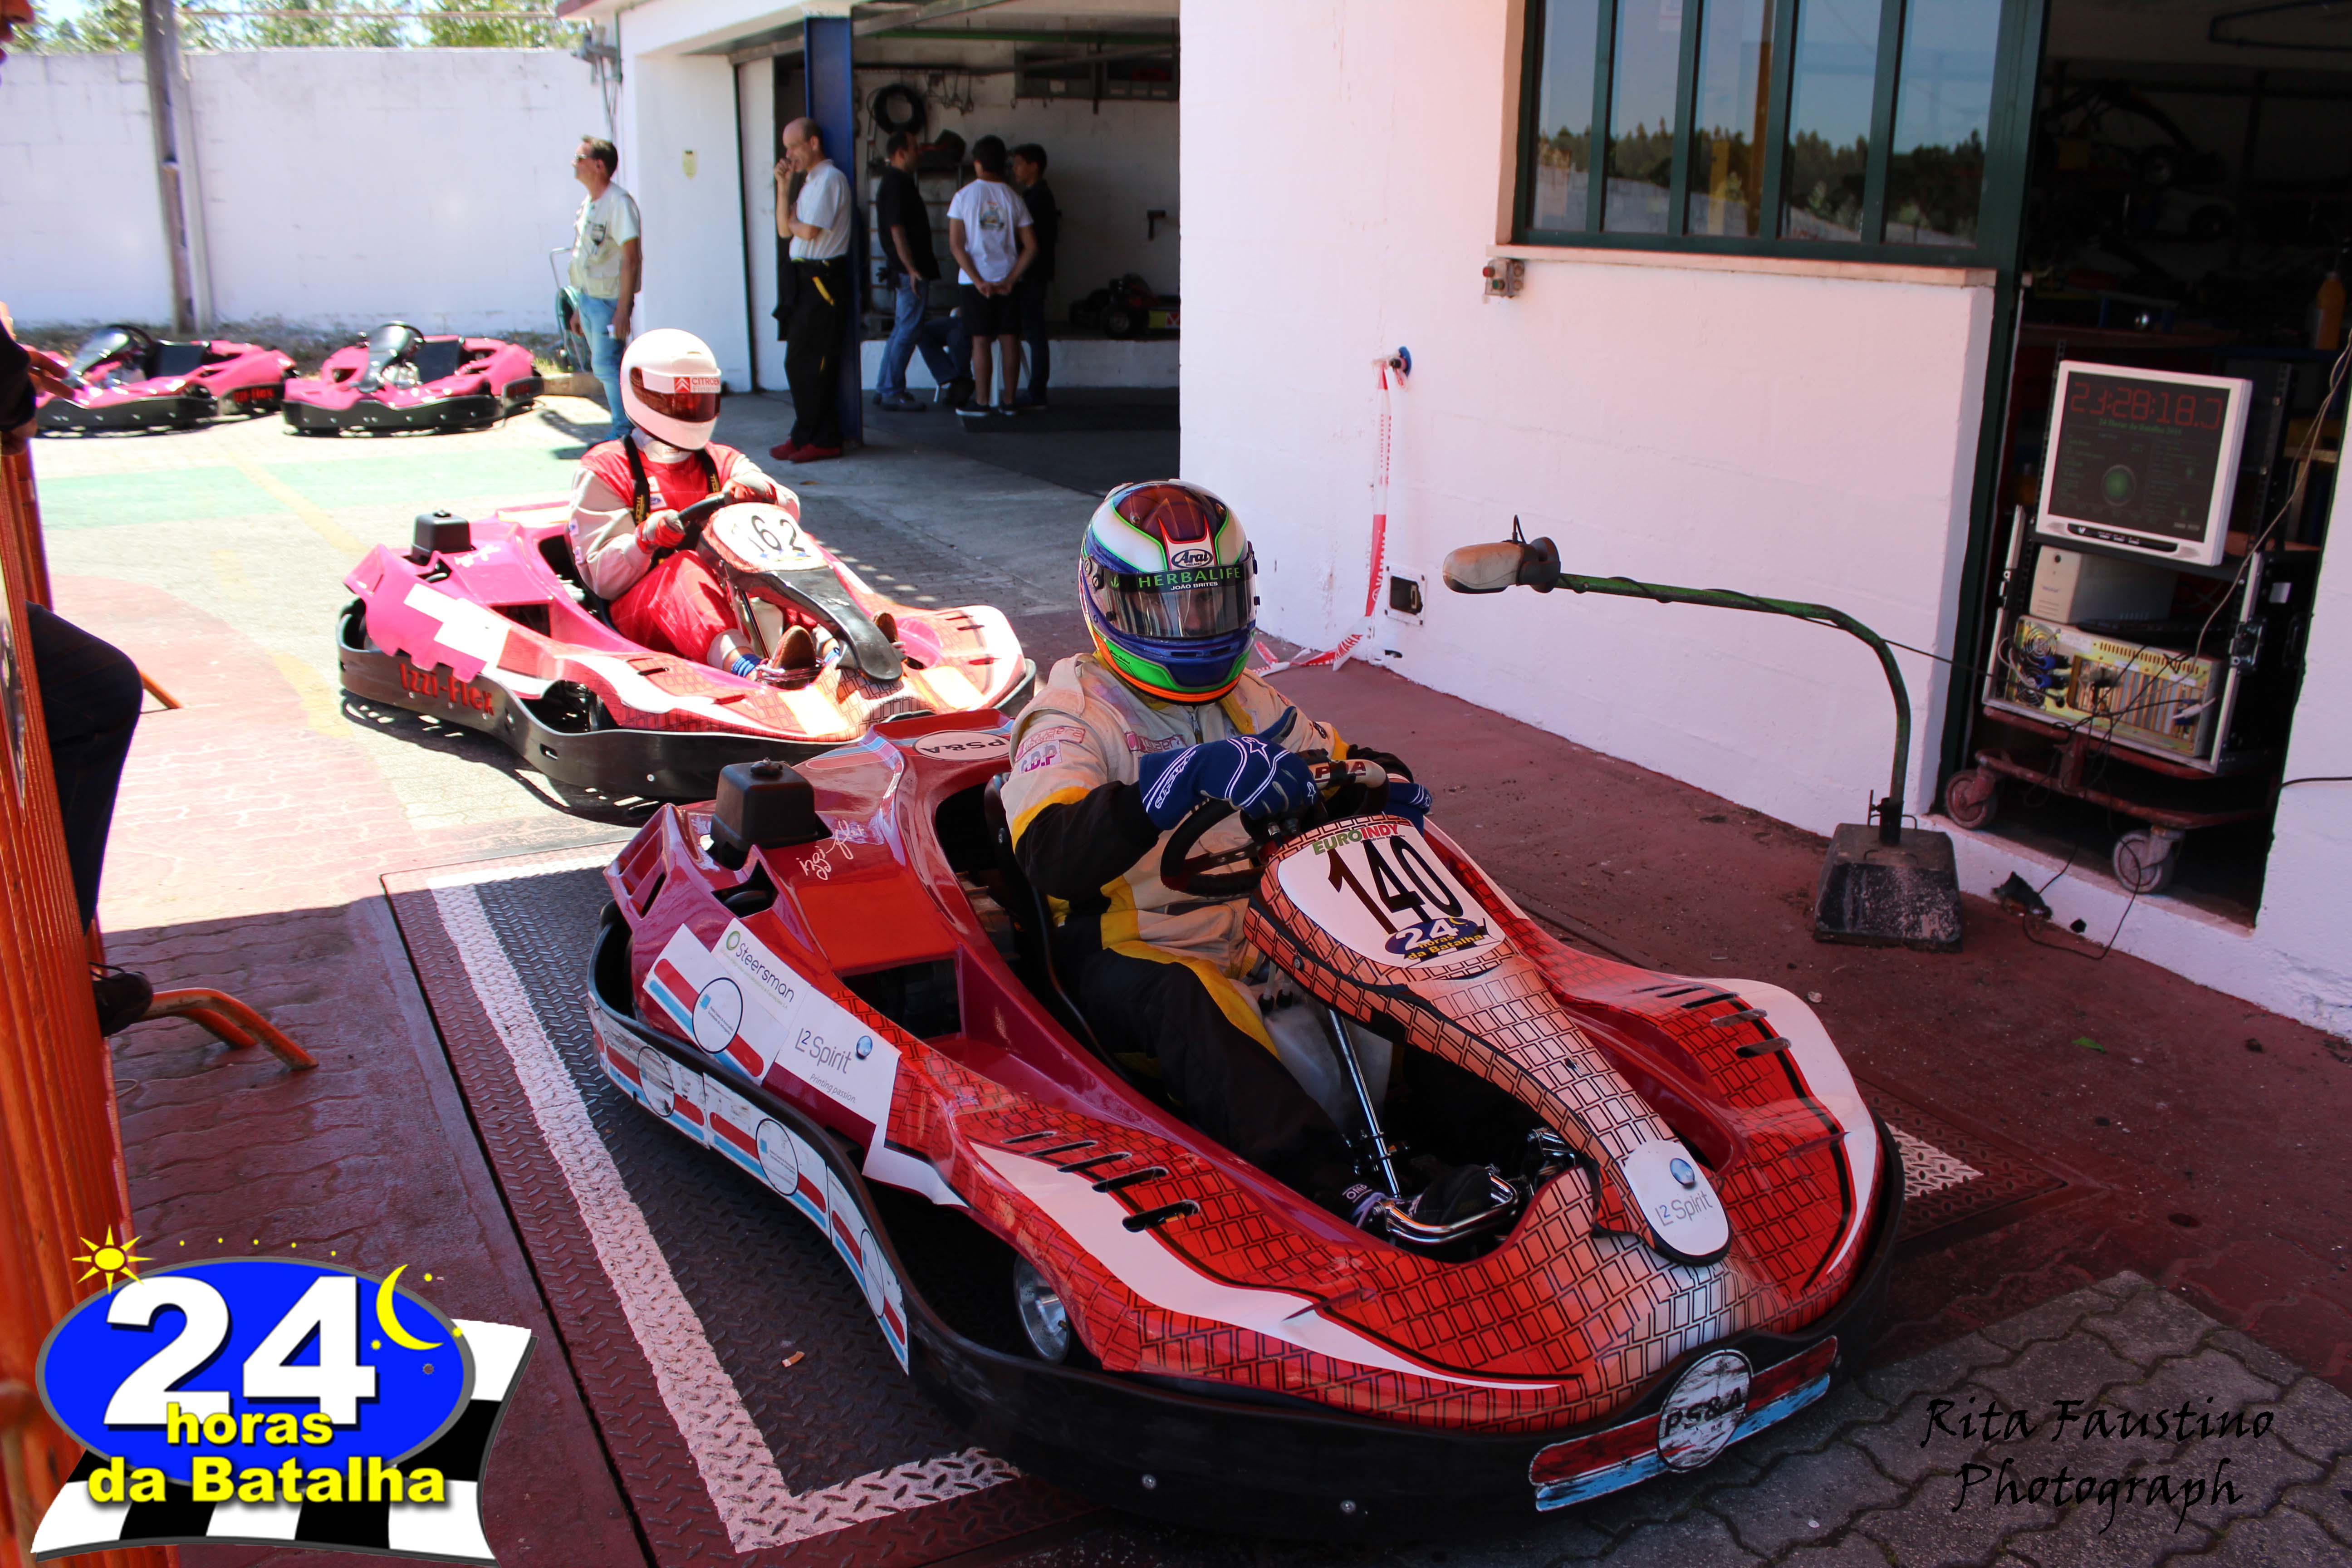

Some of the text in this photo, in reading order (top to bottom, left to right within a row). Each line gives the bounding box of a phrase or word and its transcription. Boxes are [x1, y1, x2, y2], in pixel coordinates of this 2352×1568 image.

[1176, 551, 1209, 564] Arai
[1138, 568, 1241, 588] HERBALIFE
[920, 739, 1006, 753] PS&A
[1328, 835, 1464, 935] 140
[1396, 919, 1459, 951] 24
[1408, 935, 1484, 960] da Batalha
[1417, 935, 1455, 949] horas
[736, 943, 794, 1003] Steersman
[809, 1073, 856, 1104] Printing passion.
[1346, 1184, 1367, 1199] OMP
[1665, 1387, 1742, 1437] PS&A
